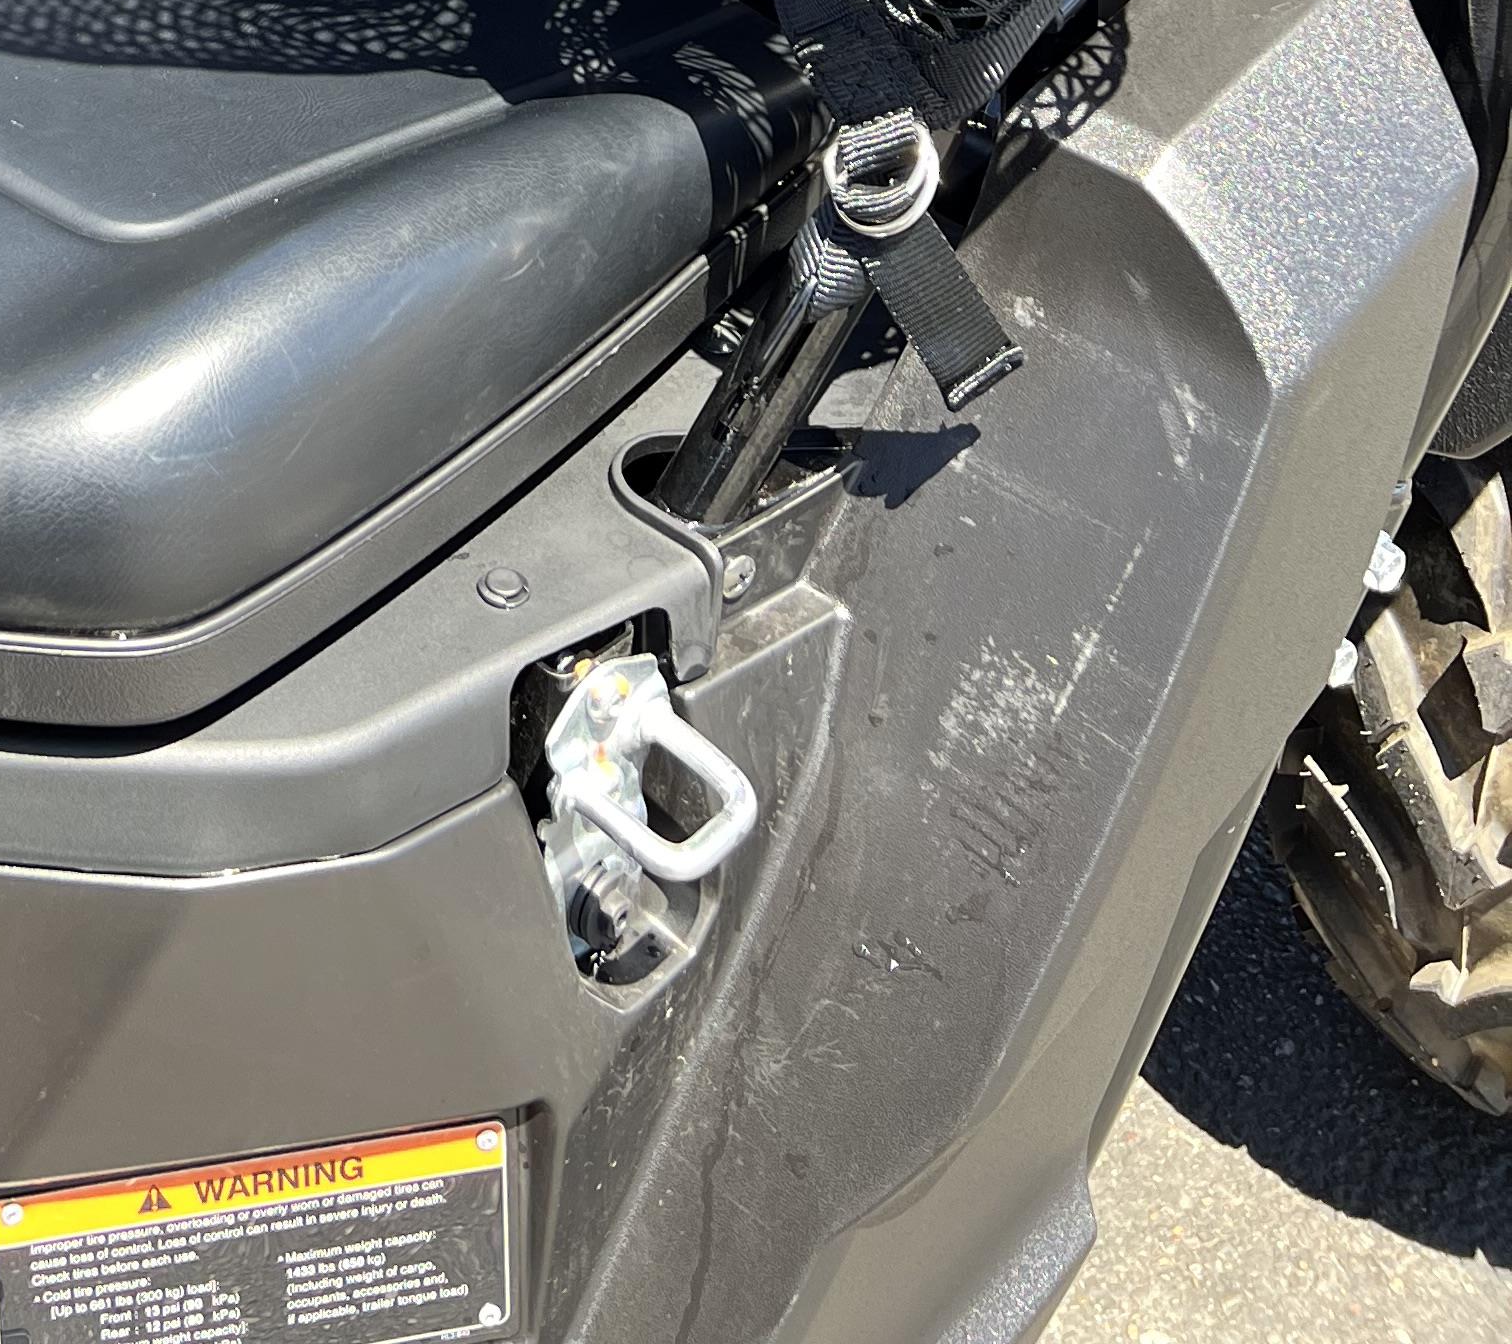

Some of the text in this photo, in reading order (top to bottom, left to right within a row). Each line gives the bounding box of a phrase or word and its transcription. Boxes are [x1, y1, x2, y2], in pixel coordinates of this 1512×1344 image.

[194, 1155, 364, 1204] WARNING
[30, 1178, 444, 1256] Improper tire pressure, overloading or overly worn or damaged tires can
[30, 1192, 447, 1271] cause loss of control. Loss of control can result in severe injury or death.
[285, 1245, 343, 1263] Maximum
[345, 1237, 383, 1254] weight
[31, 1250, 199, 1287] Check tires before each use.
[318, 1261, 335, 1274] lbs
[345, 1268, 384, 1285] weight
[385, 1265, 398, 1278] of
[42, 1276, 152, 1304] Cold tire pressure:
[352, 1278, 421, 1299] accessories
[75, 1300, 88, 1314] to
[115, 1294, 134, 1307] lbs
[100, 1310, 132, 1325] Front
[163, 1301, 180, 1317] psi
[361, 1297, 395, 1313] trailer
[397, 1291, 438, 1308] tongue
[100, 1326, 131, 1341] Rear
[163, 1316, 181, 1332] psi
